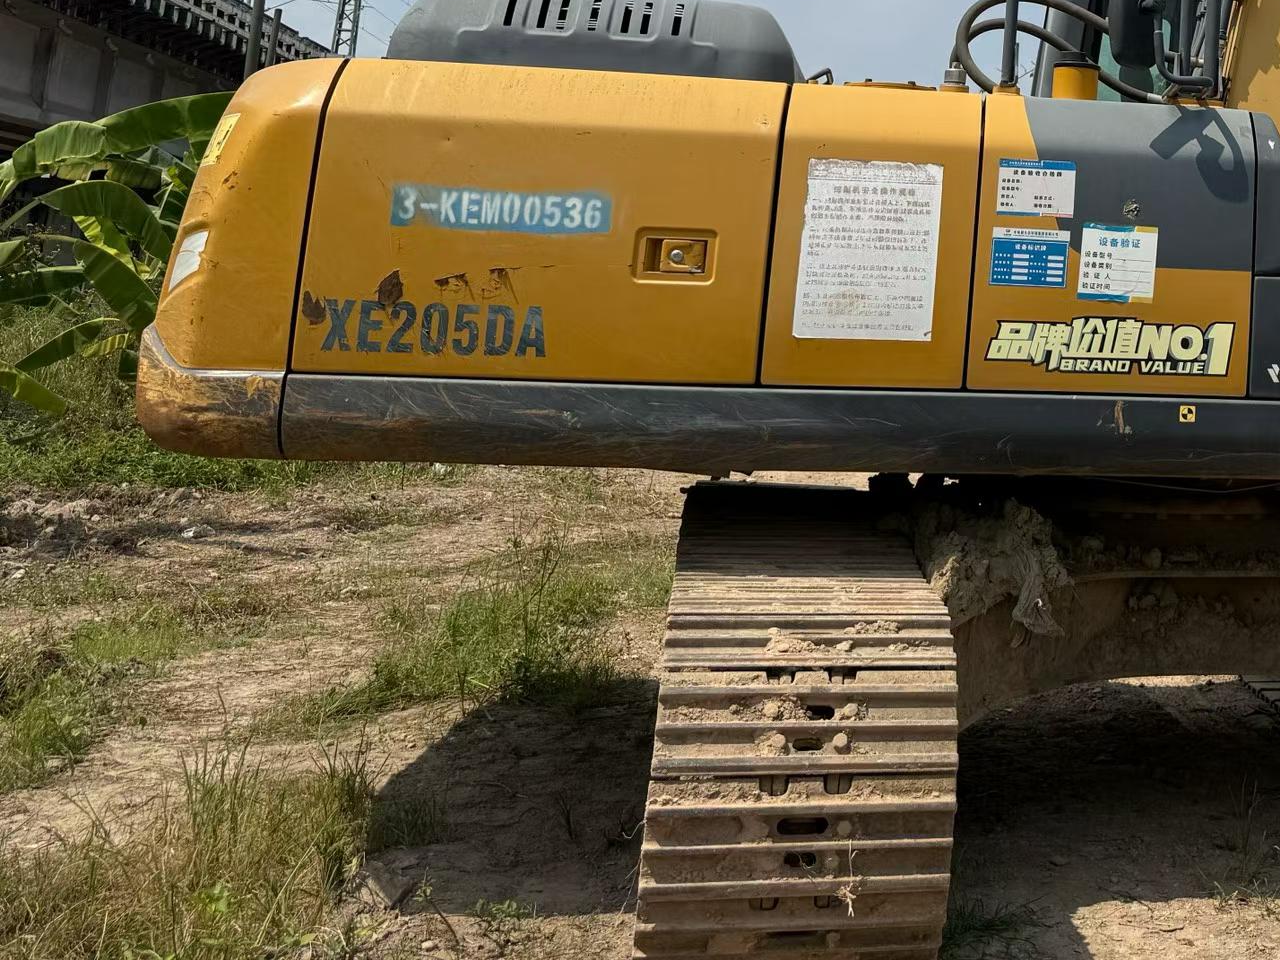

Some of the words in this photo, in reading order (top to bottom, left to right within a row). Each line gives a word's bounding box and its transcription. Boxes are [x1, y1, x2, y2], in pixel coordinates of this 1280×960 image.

[397, 186, 603, 230] 3-KEM00536
[1098, 236, 1141, 249] 设备验证
[320, 298, 547, 358] XE205DA
[1059, 358, 1131, 373] BRAND
[1140, 360, 1206, 375] VALUE
